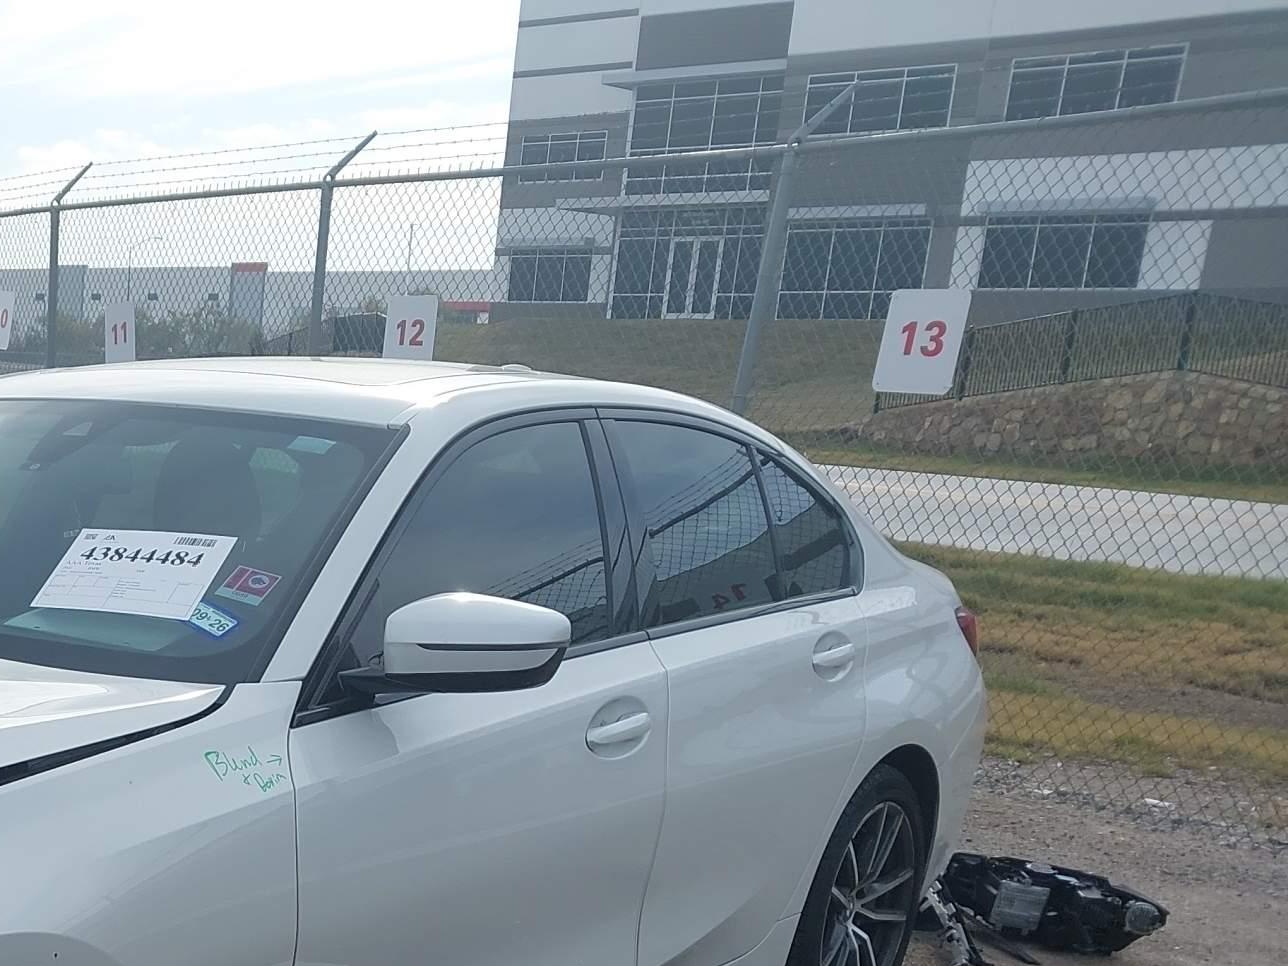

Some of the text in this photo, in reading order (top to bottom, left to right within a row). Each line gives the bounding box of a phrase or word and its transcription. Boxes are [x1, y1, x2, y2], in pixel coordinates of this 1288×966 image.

[112, 321, 127, 345] 11
[397, 319, 425, 346] 12
[902, 320, 947, 357] 13
[80, 546, 205, 568] 43844484
[208, 618, 230, 632] 26
